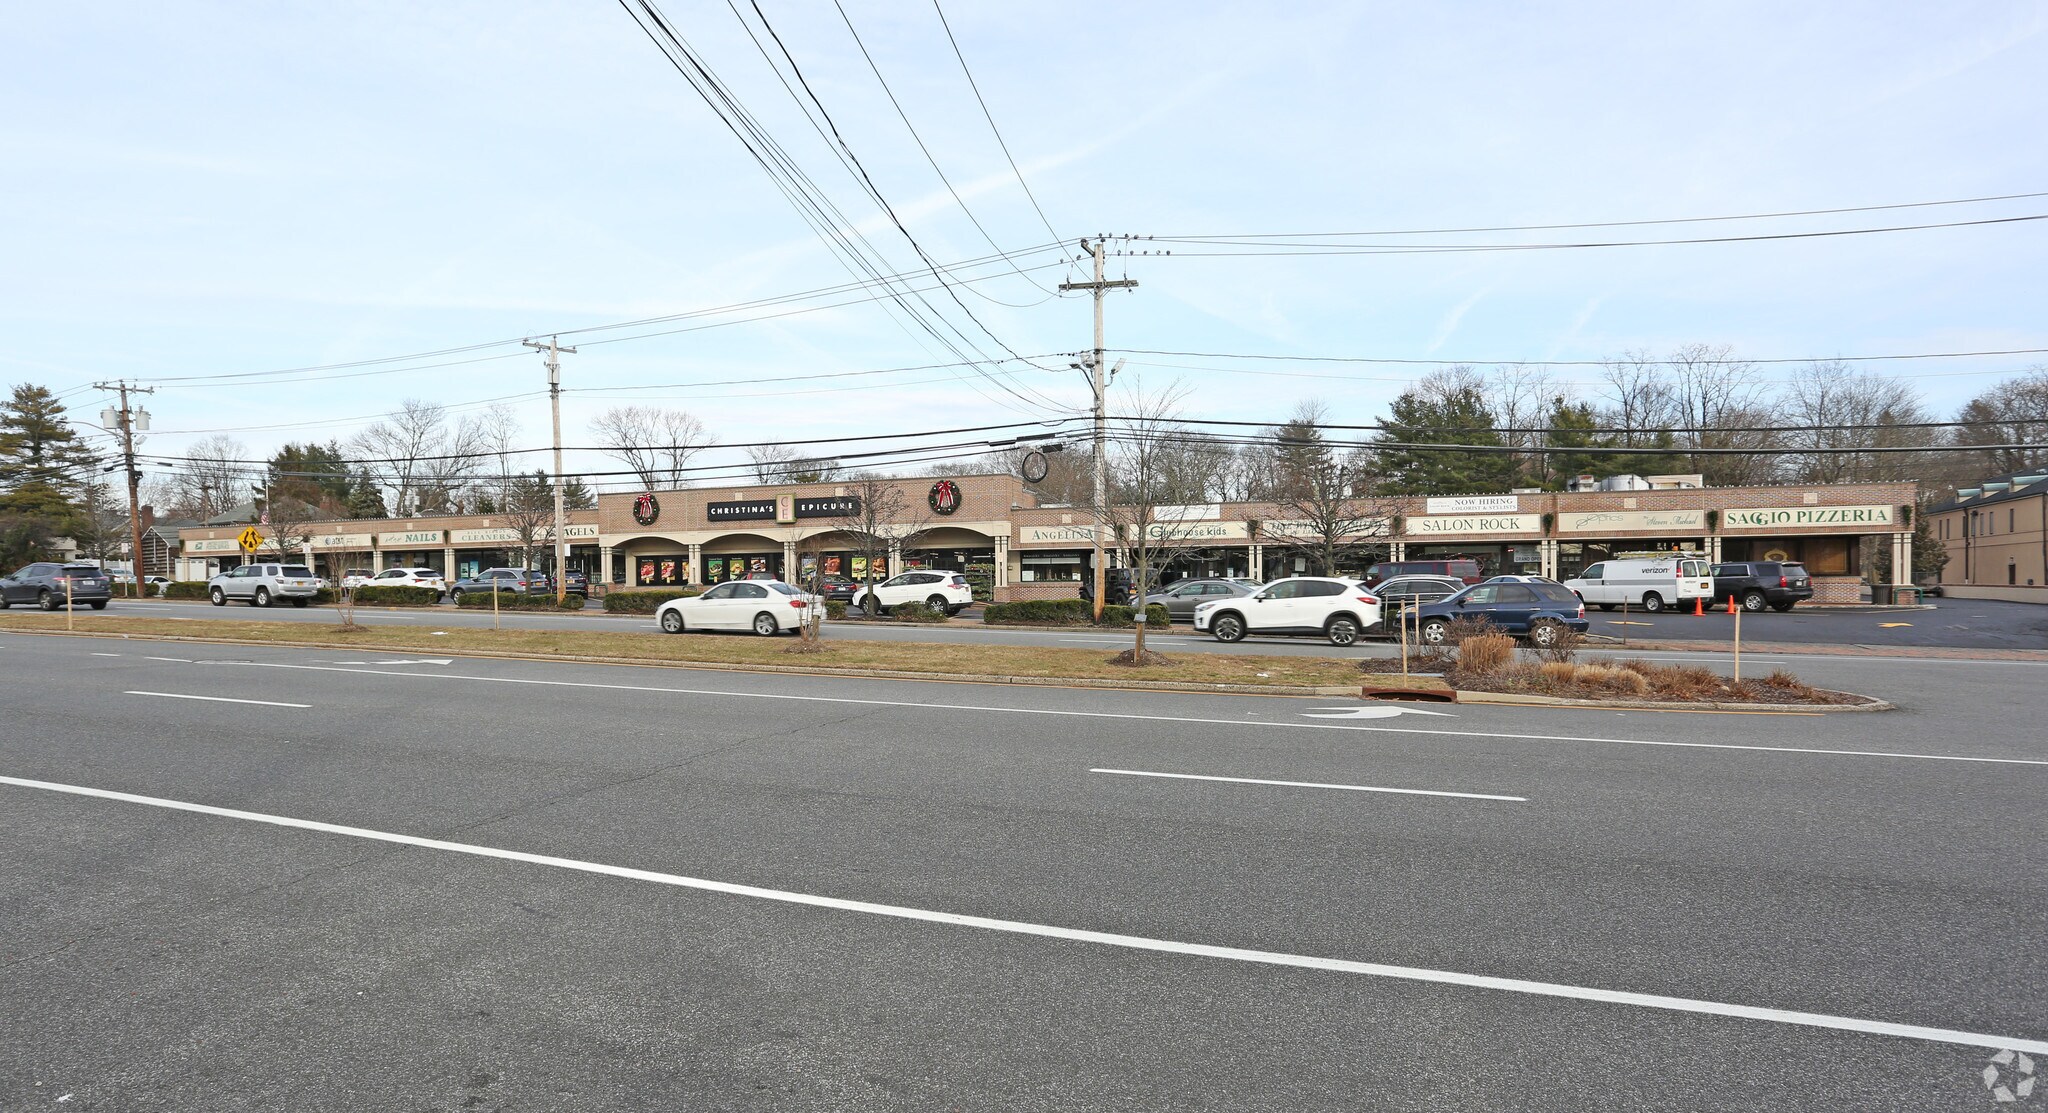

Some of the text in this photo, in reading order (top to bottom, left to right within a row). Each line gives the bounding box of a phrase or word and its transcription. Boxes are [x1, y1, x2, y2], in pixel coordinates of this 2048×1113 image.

[1479, 497, 1513, 505] HIRING
[711, 504, 774, 515] CHRISTINA'S
[801, 502, 853, 511] EPICURE
[1727, 509, 1887, 526] SAGGIO PIZZERIA
[1422, 518, 1520, 532] SALON ROCK
[564, 526, 595, 537] AGELS
[1206, 526, 1227, 536] kids
[405, 533, 437, 543] NAILS
[461, 531, 511, 542] CLEANERS
[1641, 566, 1668, 574] verizon
